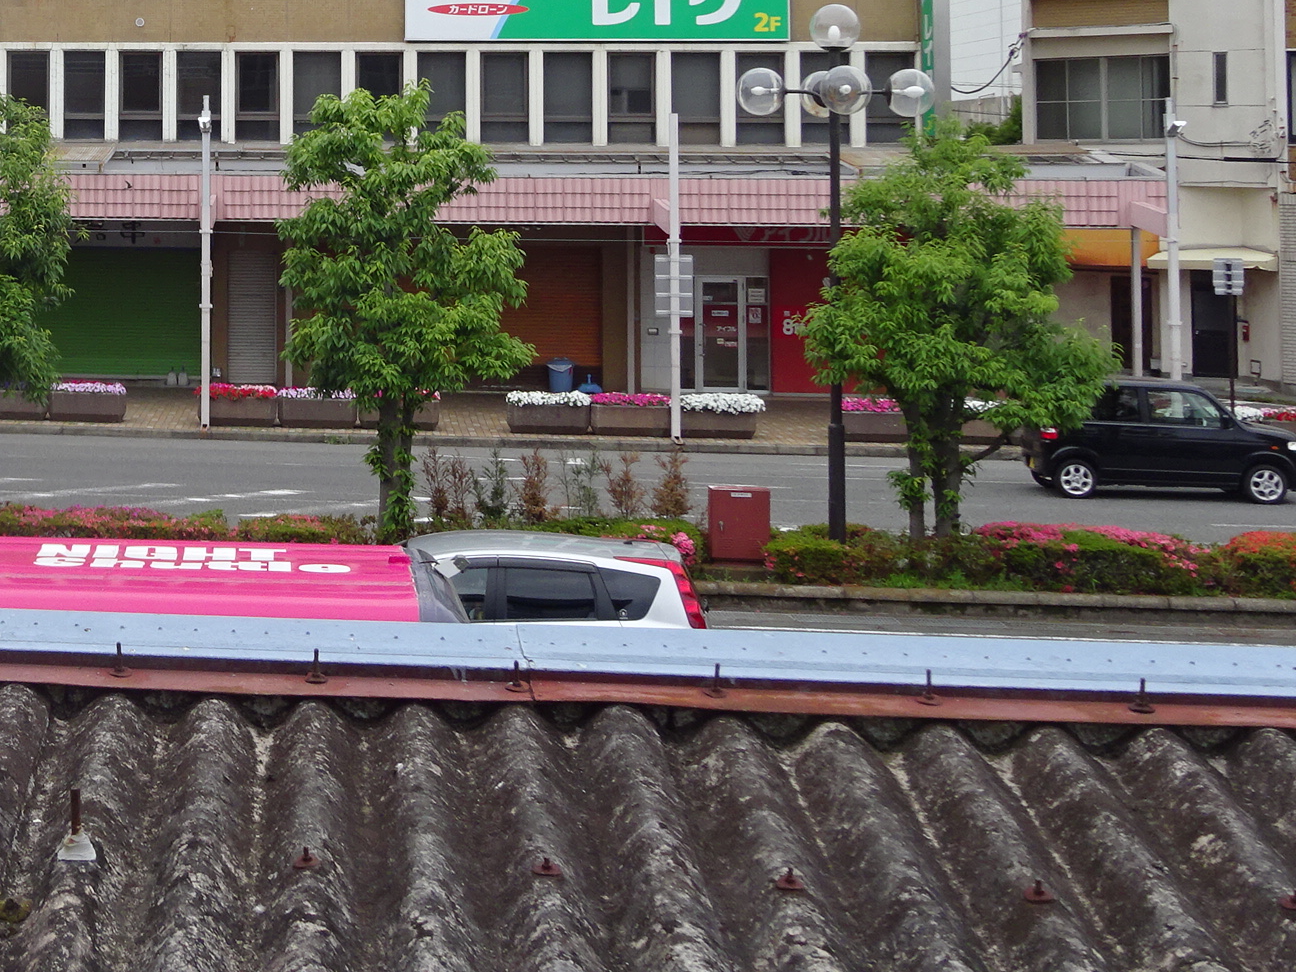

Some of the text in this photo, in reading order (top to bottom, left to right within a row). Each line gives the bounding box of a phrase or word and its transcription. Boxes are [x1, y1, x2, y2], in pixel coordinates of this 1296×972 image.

[449, 4, 508, 15] カードローン
[754, 12, 782, 32] 2F
[36, 543, 287, 562] NIGHT
